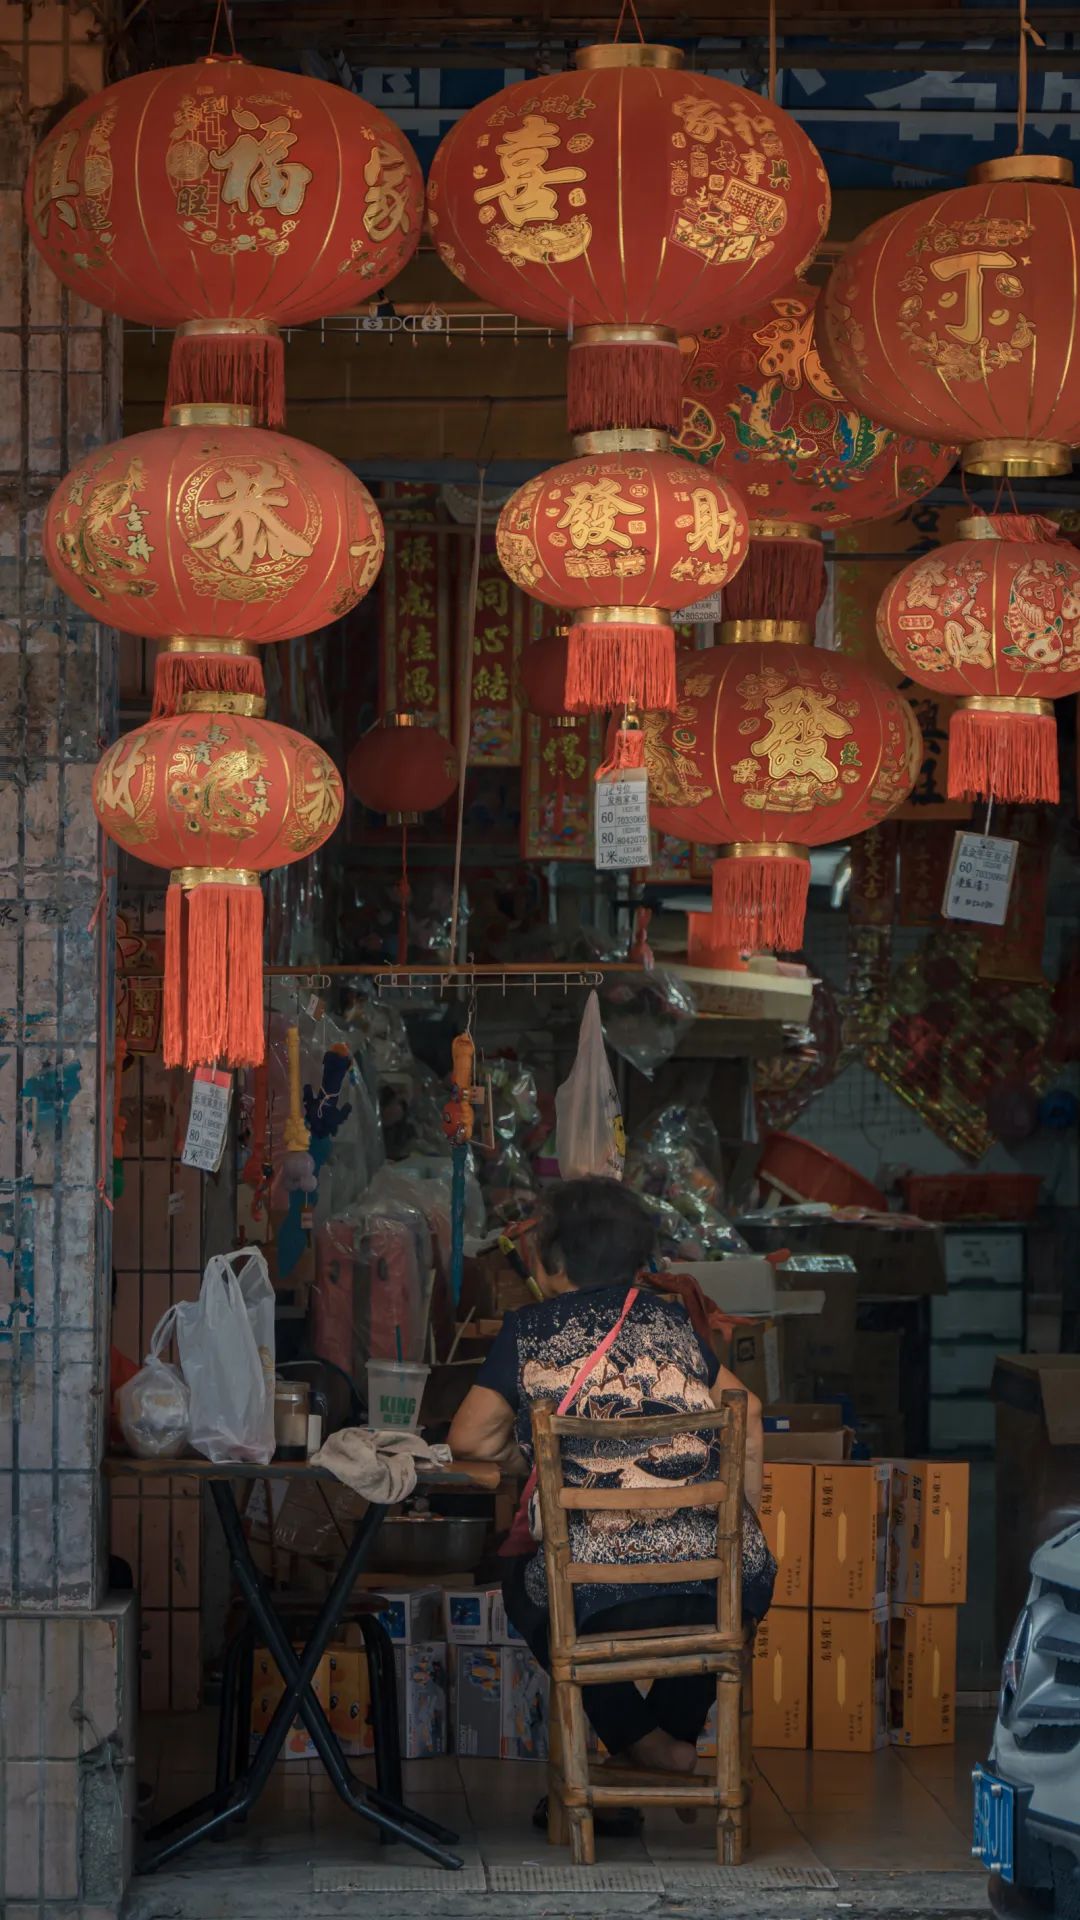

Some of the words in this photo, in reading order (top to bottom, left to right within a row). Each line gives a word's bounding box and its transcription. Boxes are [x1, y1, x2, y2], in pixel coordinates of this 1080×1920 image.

[930, 250, 1018, 345] 丁
[601, 811, 614, 824] 60
[601, 831, 614, 844] 80
[959, 861, 972, 874] 60
[192, 1110, 203, 1122] 60
[190, 1129, 201, 1142] 80
